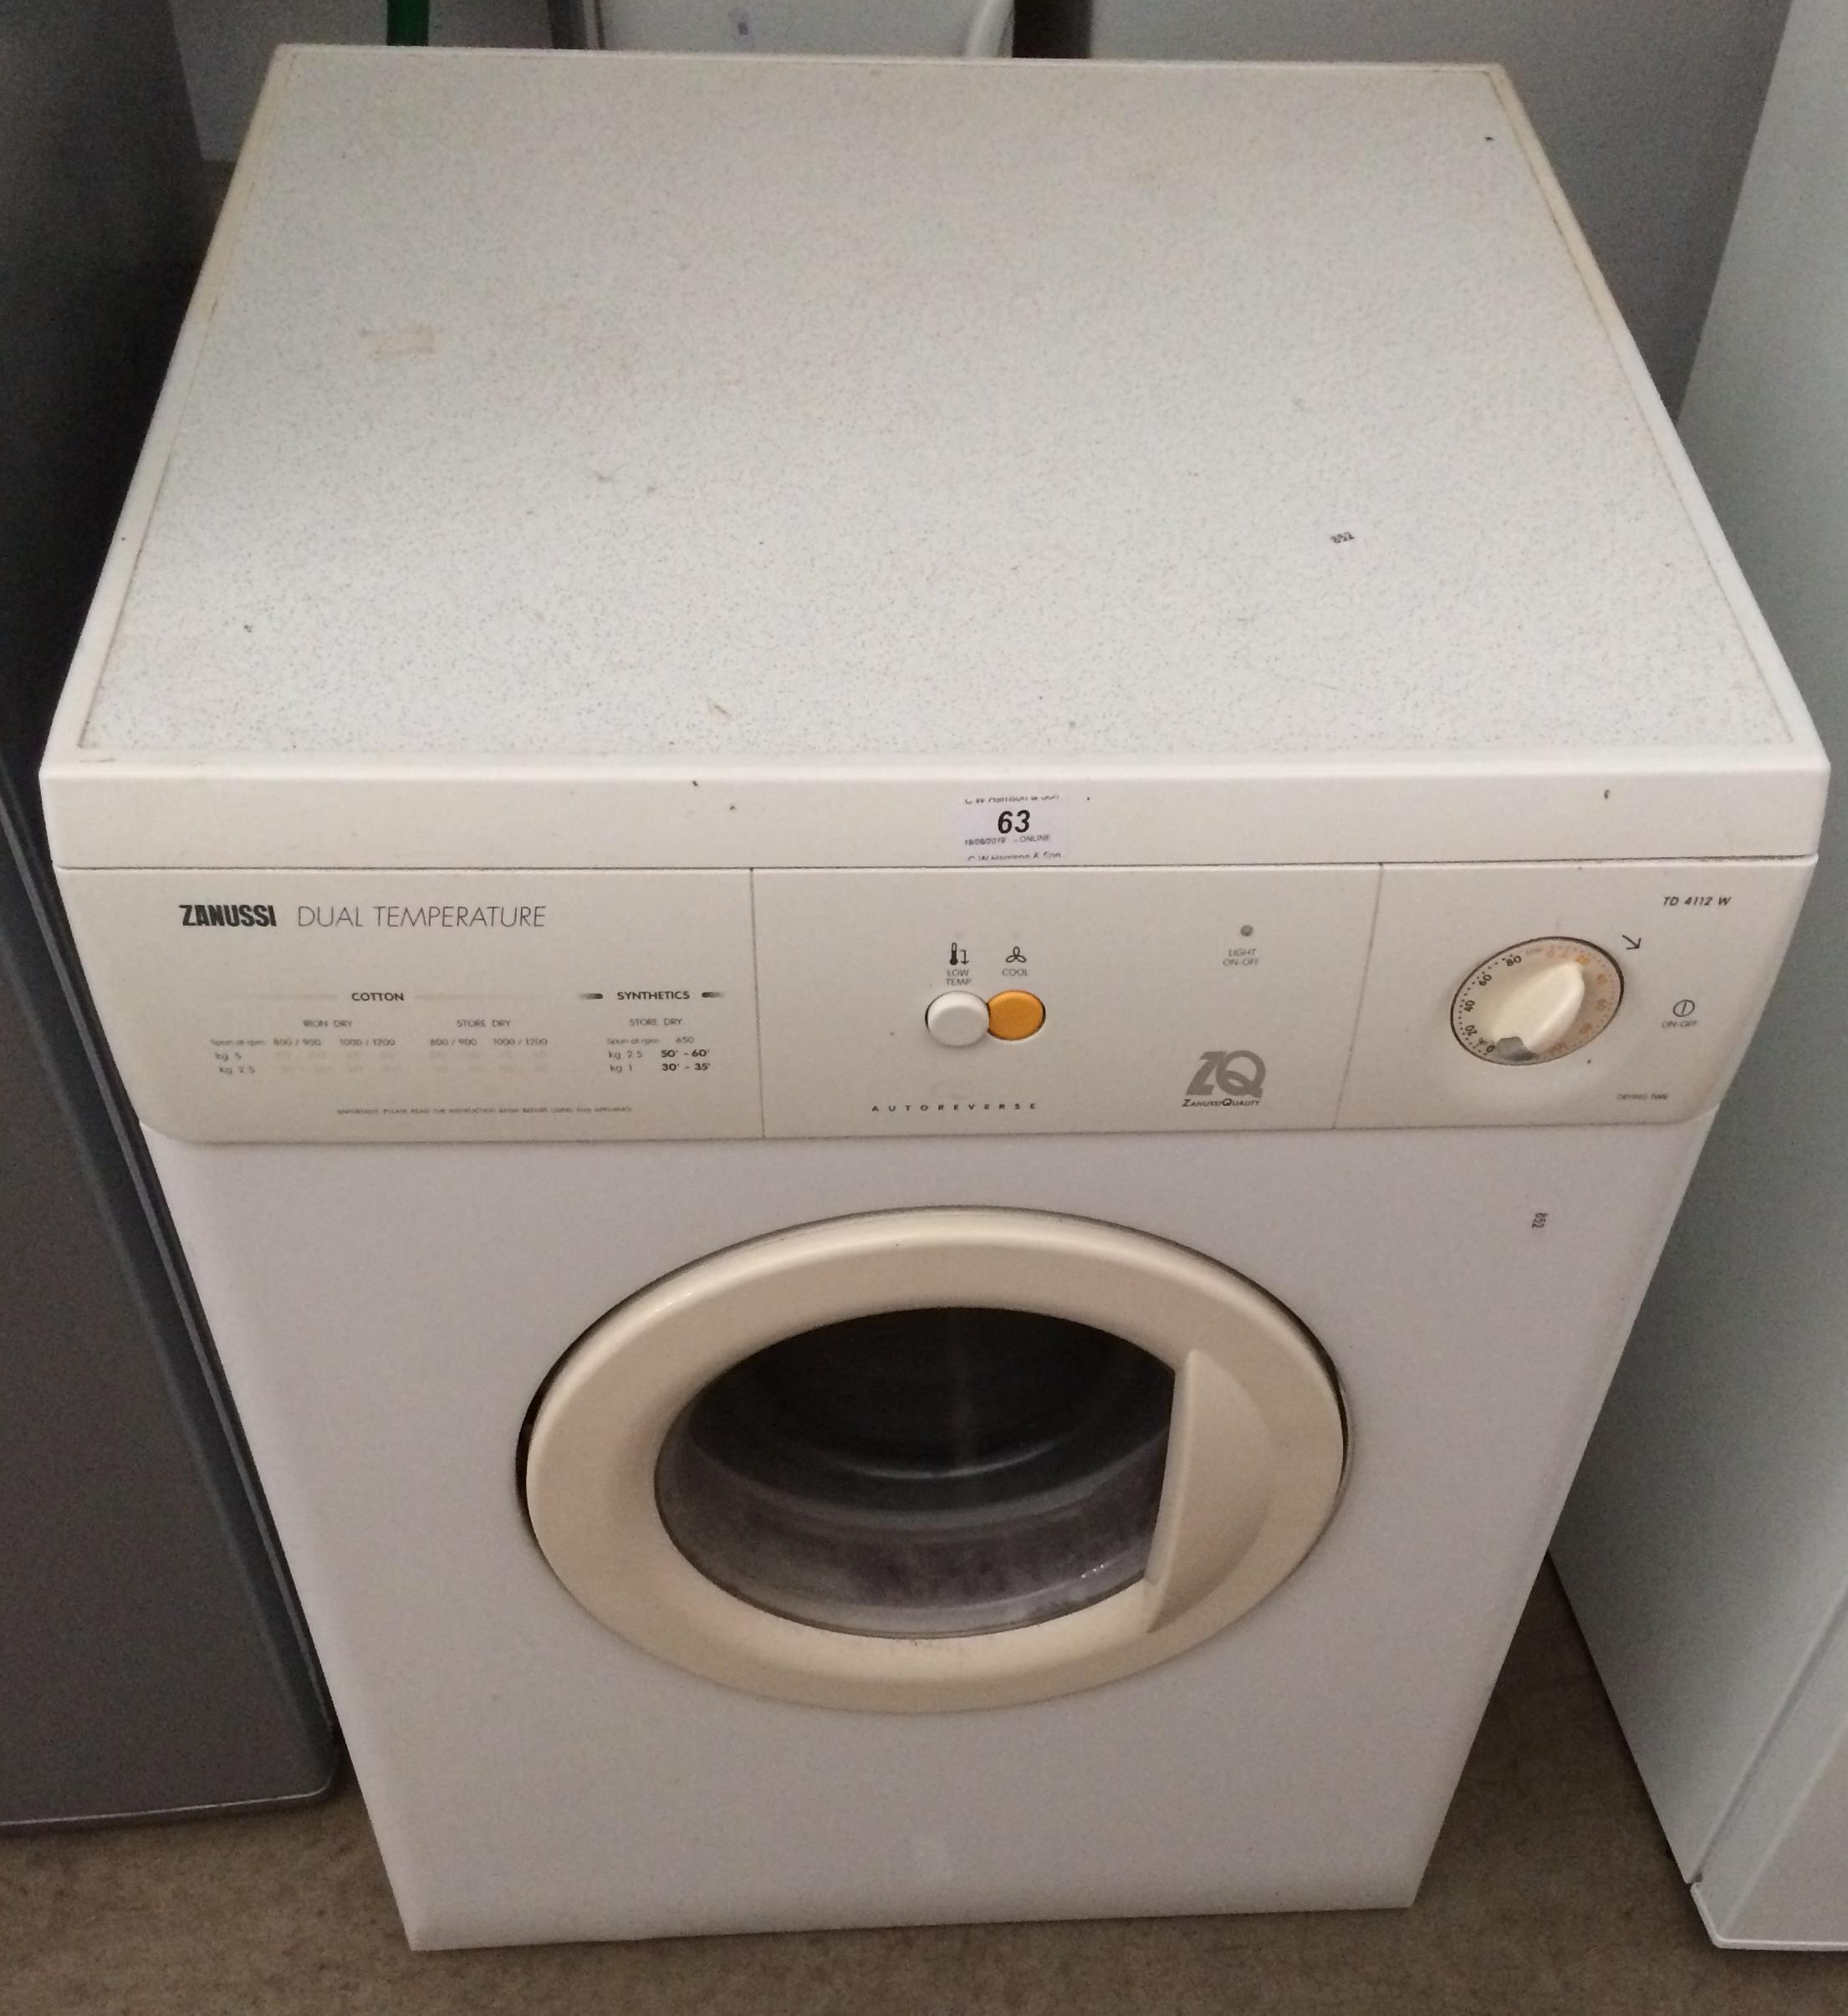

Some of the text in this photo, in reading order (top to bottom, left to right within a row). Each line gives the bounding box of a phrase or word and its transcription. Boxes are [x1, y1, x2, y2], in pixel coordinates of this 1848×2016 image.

[998, 809, 1030, 834] 63
[1019, 834, 1050, 843] ONLINE
[1662, 896, 1732, 906] TD 4112 W
[178, 904, 547, 927] ZANUSSI DUAL TEMPERATURE
[1506, 955, 1522, 967] 80
[1002, 968, 1029, 977] COOL
[1478, 973, 1493, 986] 60
[351, 992, 405, 1002] COTTON
[617, 990, 691, 1000] SYNTHETICS
[1463, 999, 1476, 1013] 40
[333, 1019, 353, 1028] DRY
[457, 1019, 511, 1028] STORE DRY
[629, 1018, 682, 1027] STORE DRY
[1464, 1024, 1478, 1036] 20
[609, 1050, 621, 1060] kg
[610, 1064, 622, 1073] kg
[871, 1103, 1037, 1111] AUTOREVERSE
